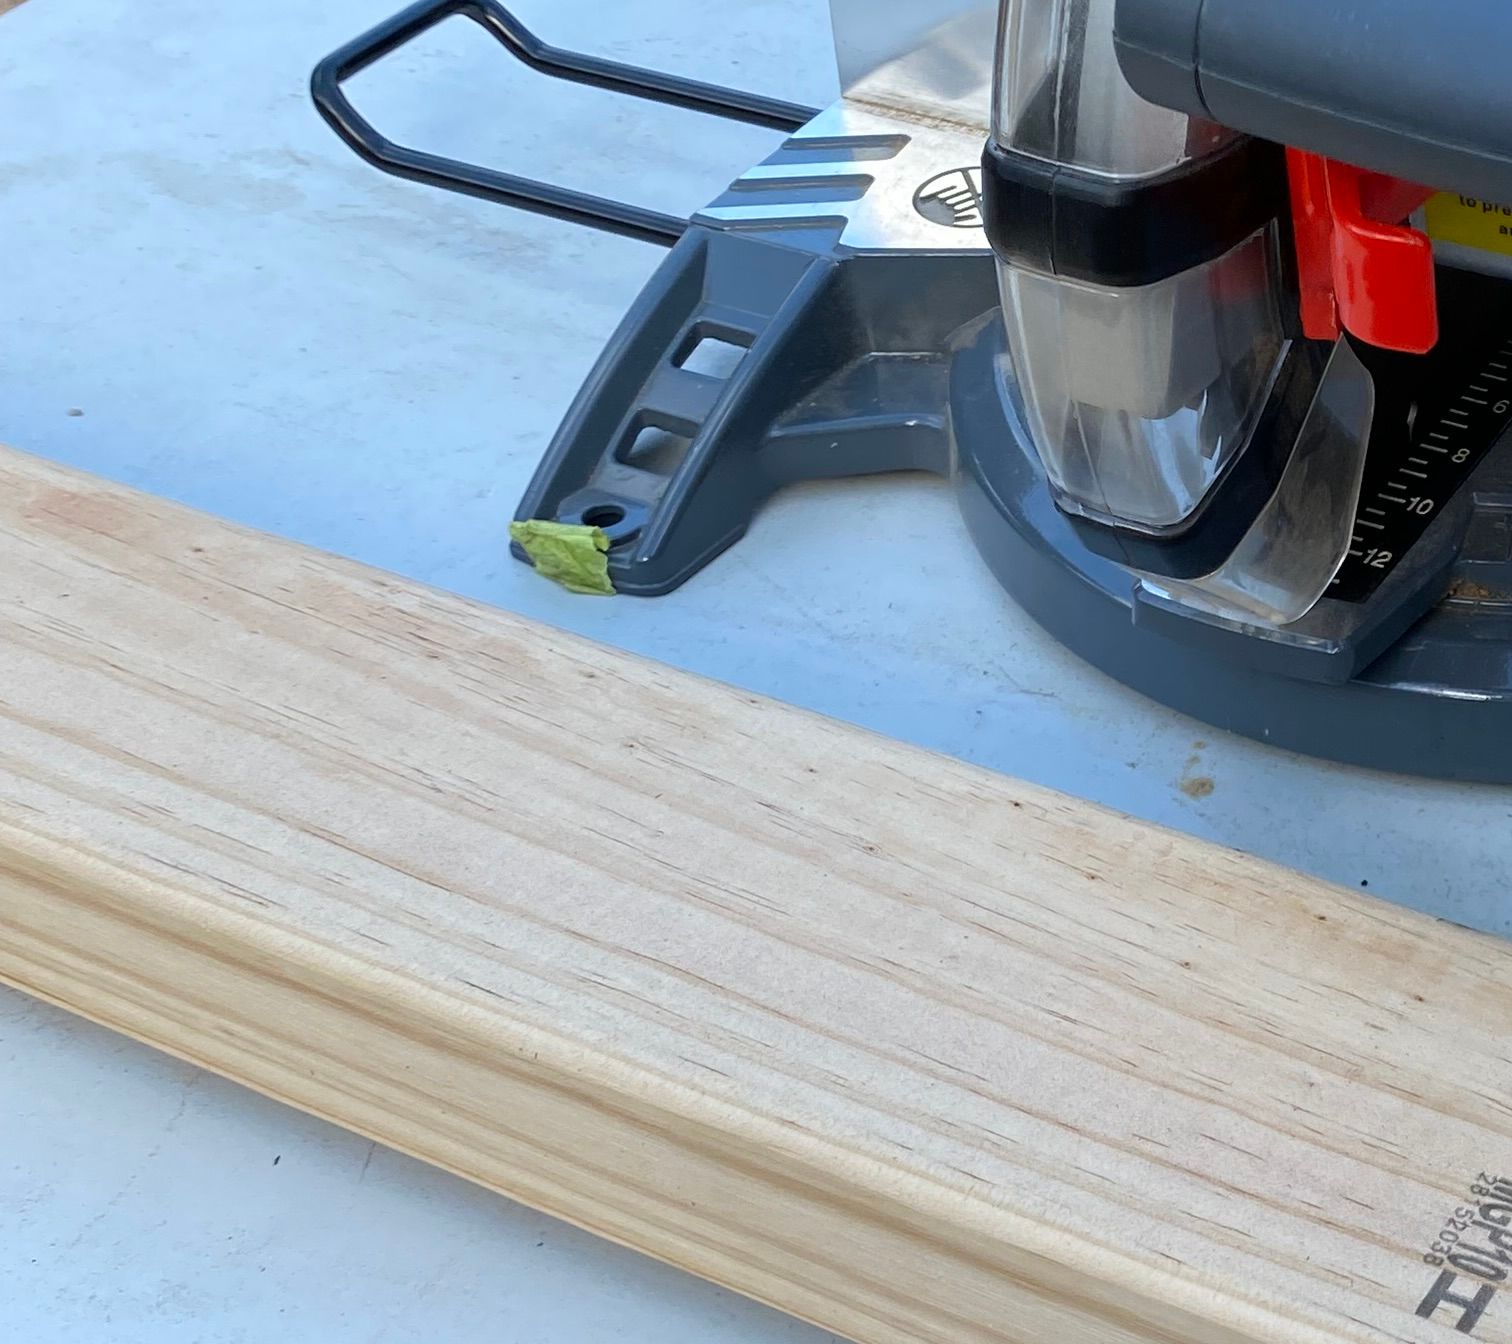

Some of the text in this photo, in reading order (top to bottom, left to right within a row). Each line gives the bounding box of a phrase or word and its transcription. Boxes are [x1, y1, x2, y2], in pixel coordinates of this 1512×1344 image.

[1459, 193, 1477, 208] to
[1491, 399, 1512, 415] 6
[1450, 447, 1472, 464] 8
[1406, 495, 1435, 516] 10
[1361, 547, 1394, 570] 12
